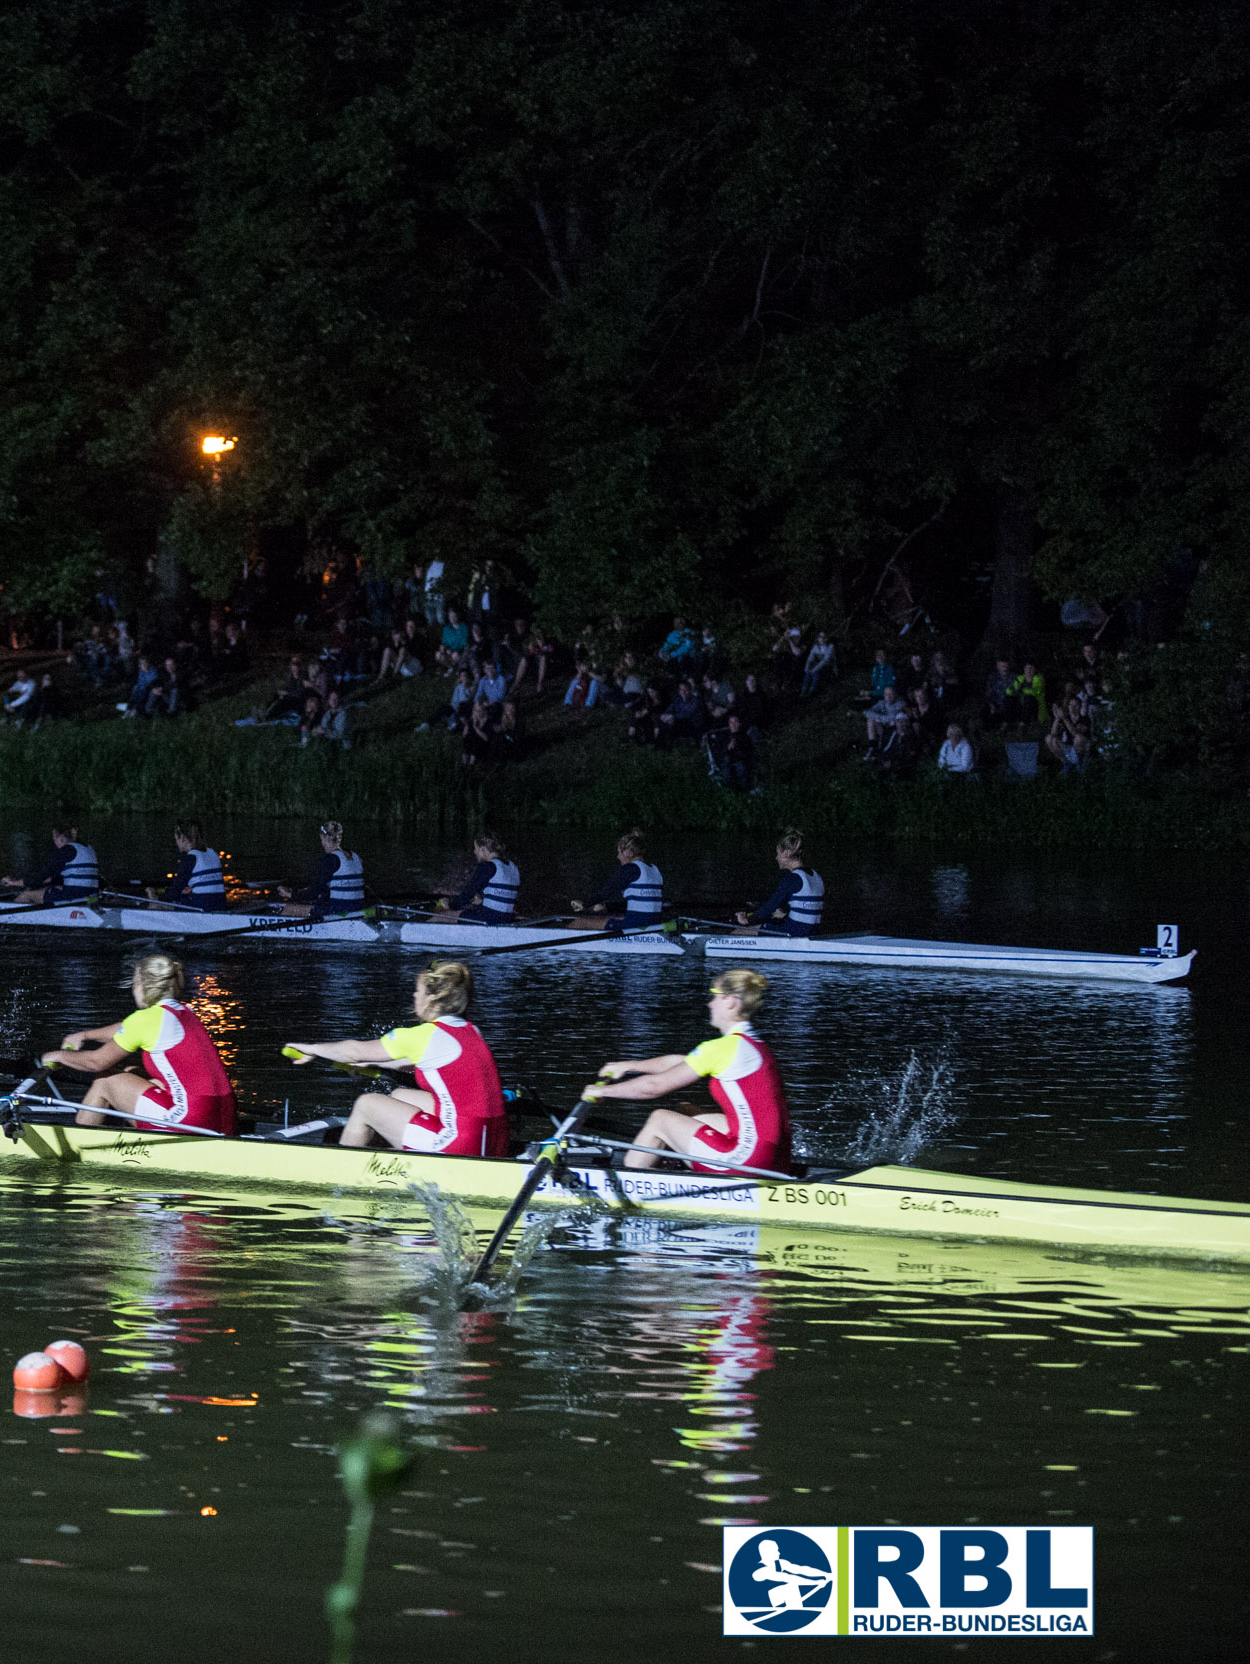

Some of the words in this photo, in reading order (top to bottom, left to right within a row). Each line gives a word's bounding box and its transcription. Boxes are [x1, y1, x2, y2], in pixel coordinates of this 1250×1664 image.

[1163, 926, 1173, 947] 2
[107, 1132, 152, 1159] Melitta
[363, 1152, 409, 1178] Melitta
[768, 1186, 779, 1202] Z
[785, 1188, 809, 1204] BS
[815, 1190, 847, 1207] 001
[899, 1196, 937, 1211] Erich
